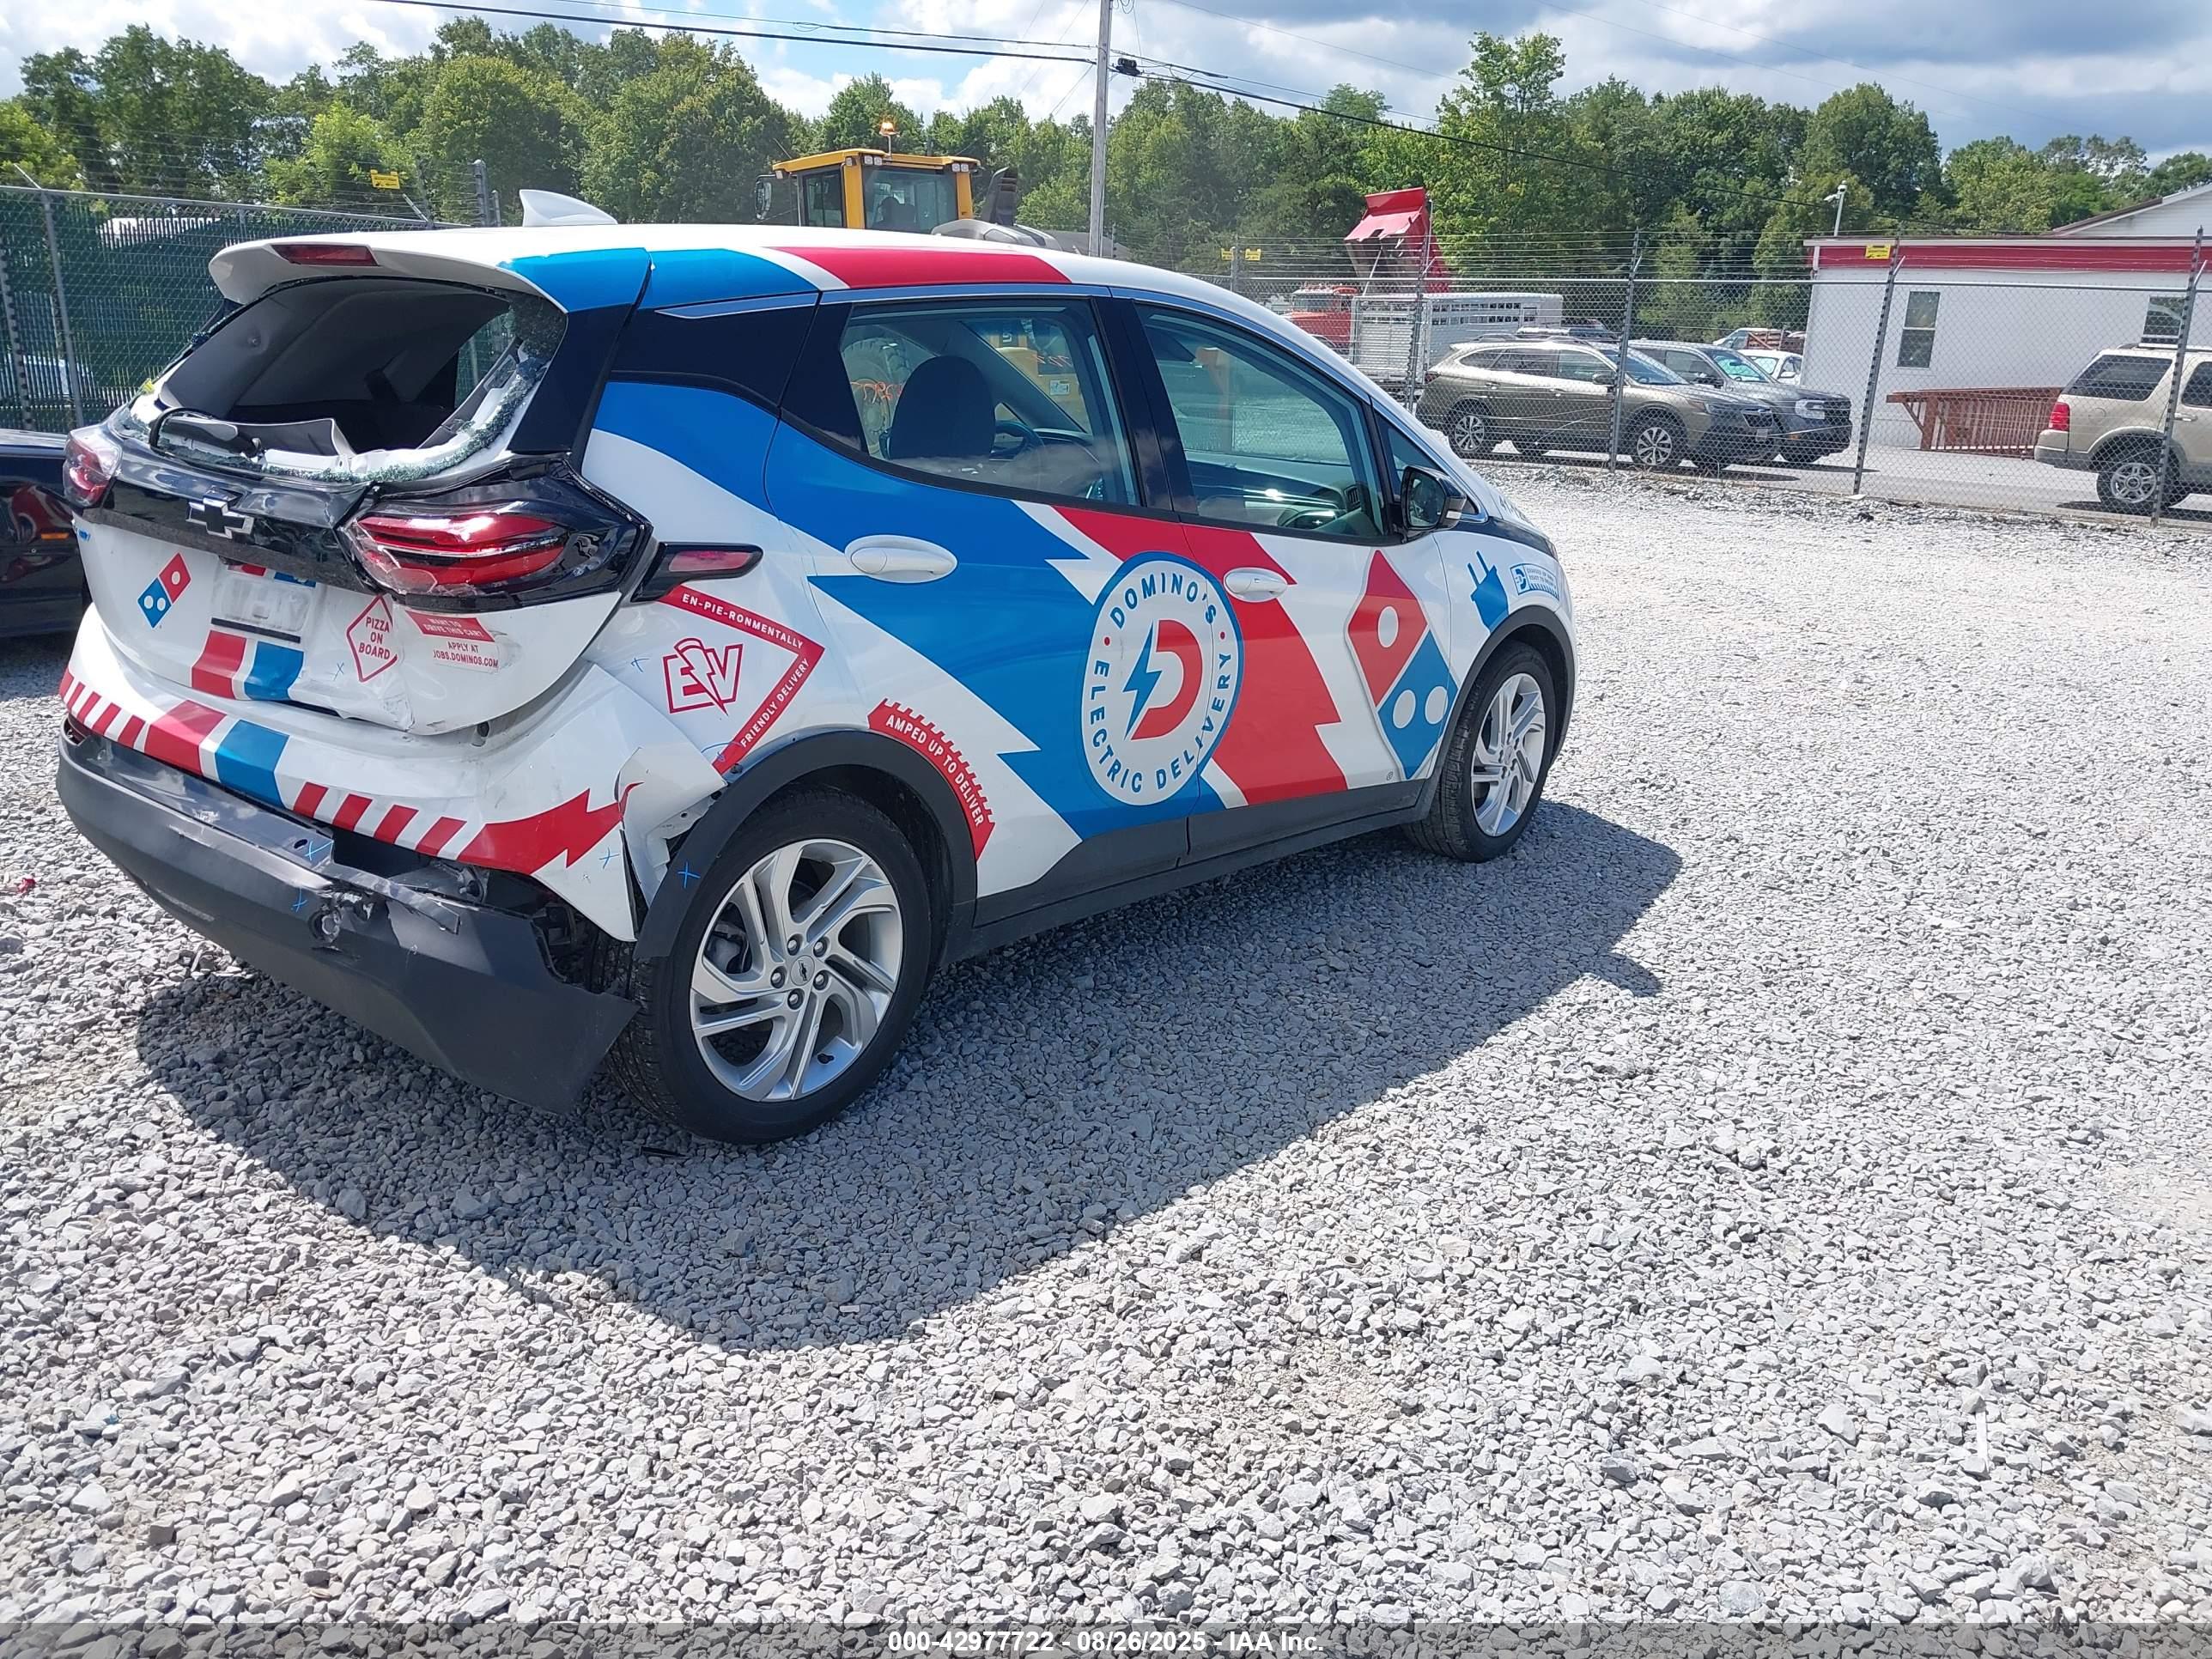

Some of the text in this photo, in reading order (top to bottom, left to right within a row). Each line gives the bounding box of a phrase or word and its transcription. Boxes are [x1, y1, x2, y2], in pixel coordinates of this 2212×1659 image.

[1109, 572, 1217, 629] DOMINO'S
[365, 616, 391, 634] PIZZA
[370, 631, 384, 645] ON
[682, 593, 804, 650] EN-PIE-RONMENTALLY
[358, 641, 391, 660] BOARD
[433, 649, 499, 668] JOBS.DOMINOS.COM
[447, 641, 479, 653] APPLY AT
[740, 658, 810, 749] FRIENDLY DELIVERY
[1090, 653, 1231, 793] ELECTRIC DELIVERY
[885, 714, 984, 827] AMPED UP TO DELIVER
